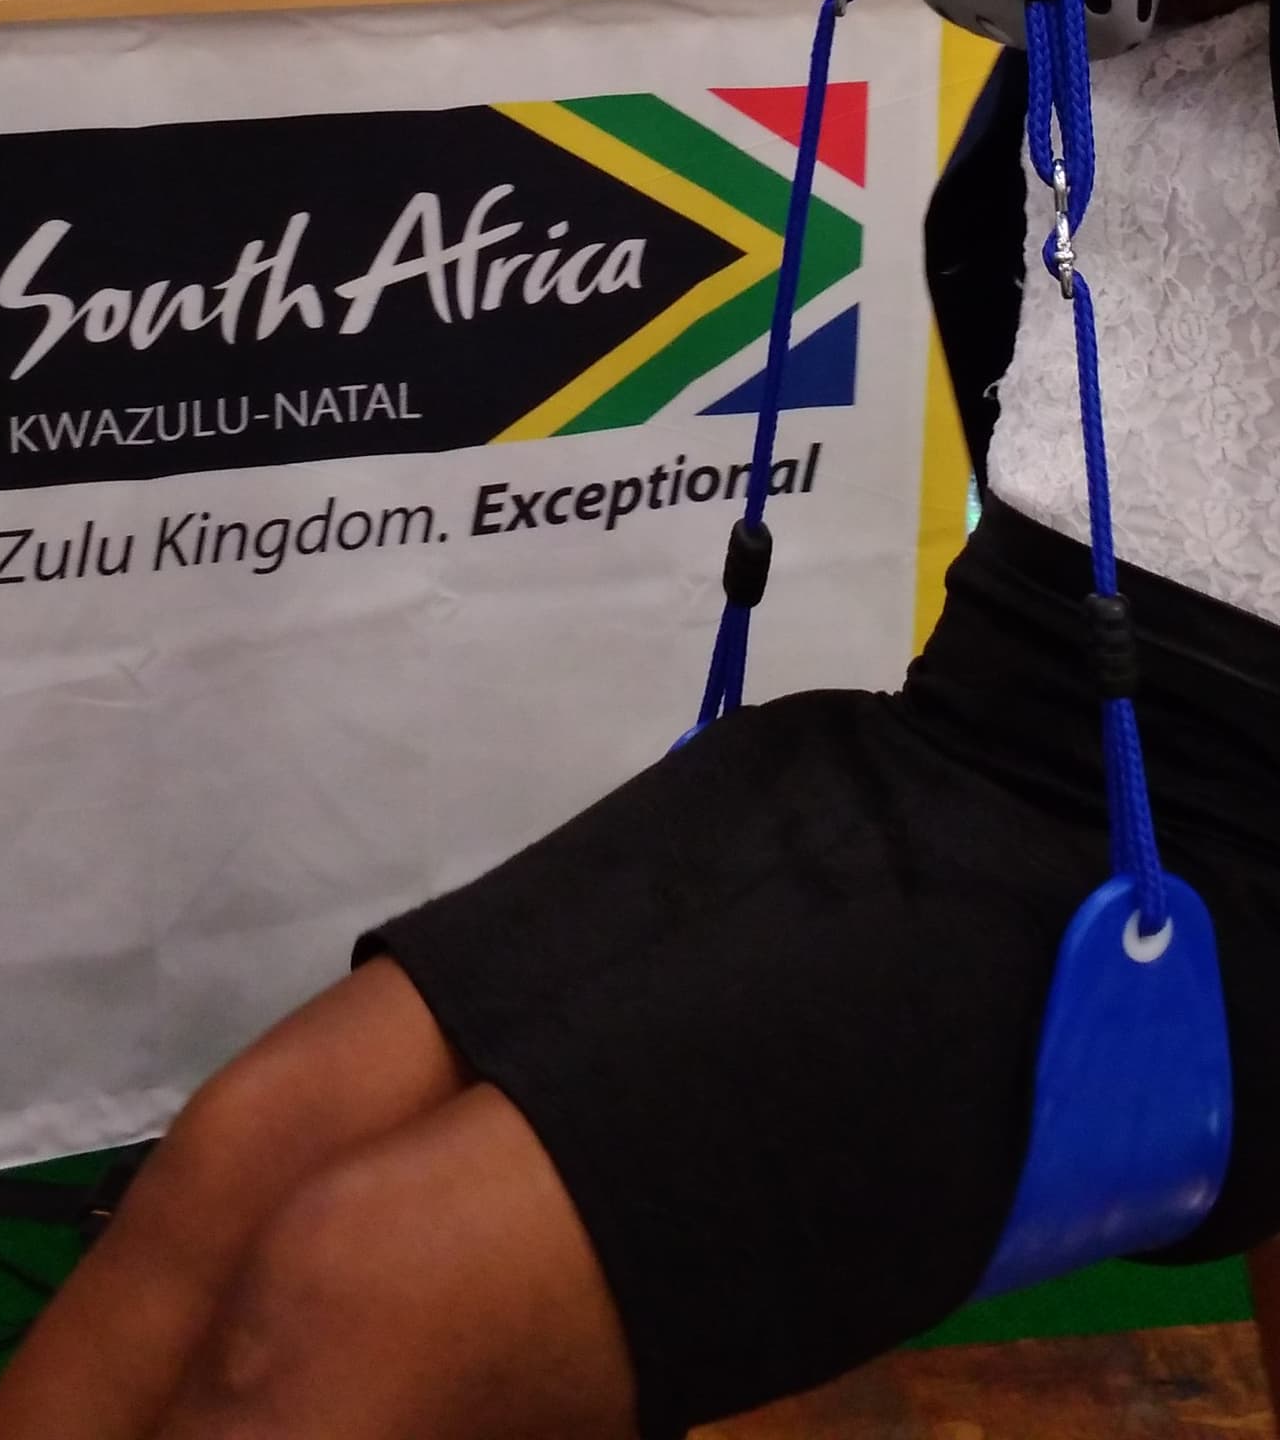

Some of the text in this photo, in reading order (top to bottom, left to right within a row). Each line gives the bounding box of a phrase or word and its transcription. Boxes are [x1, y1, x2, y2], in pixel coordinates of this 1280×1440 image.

[334, 183, 648, 335] Africa
[9, 383, 422, 454] KWAZULU-NATAL
[154, 496, 450, 575] Kingdom.
